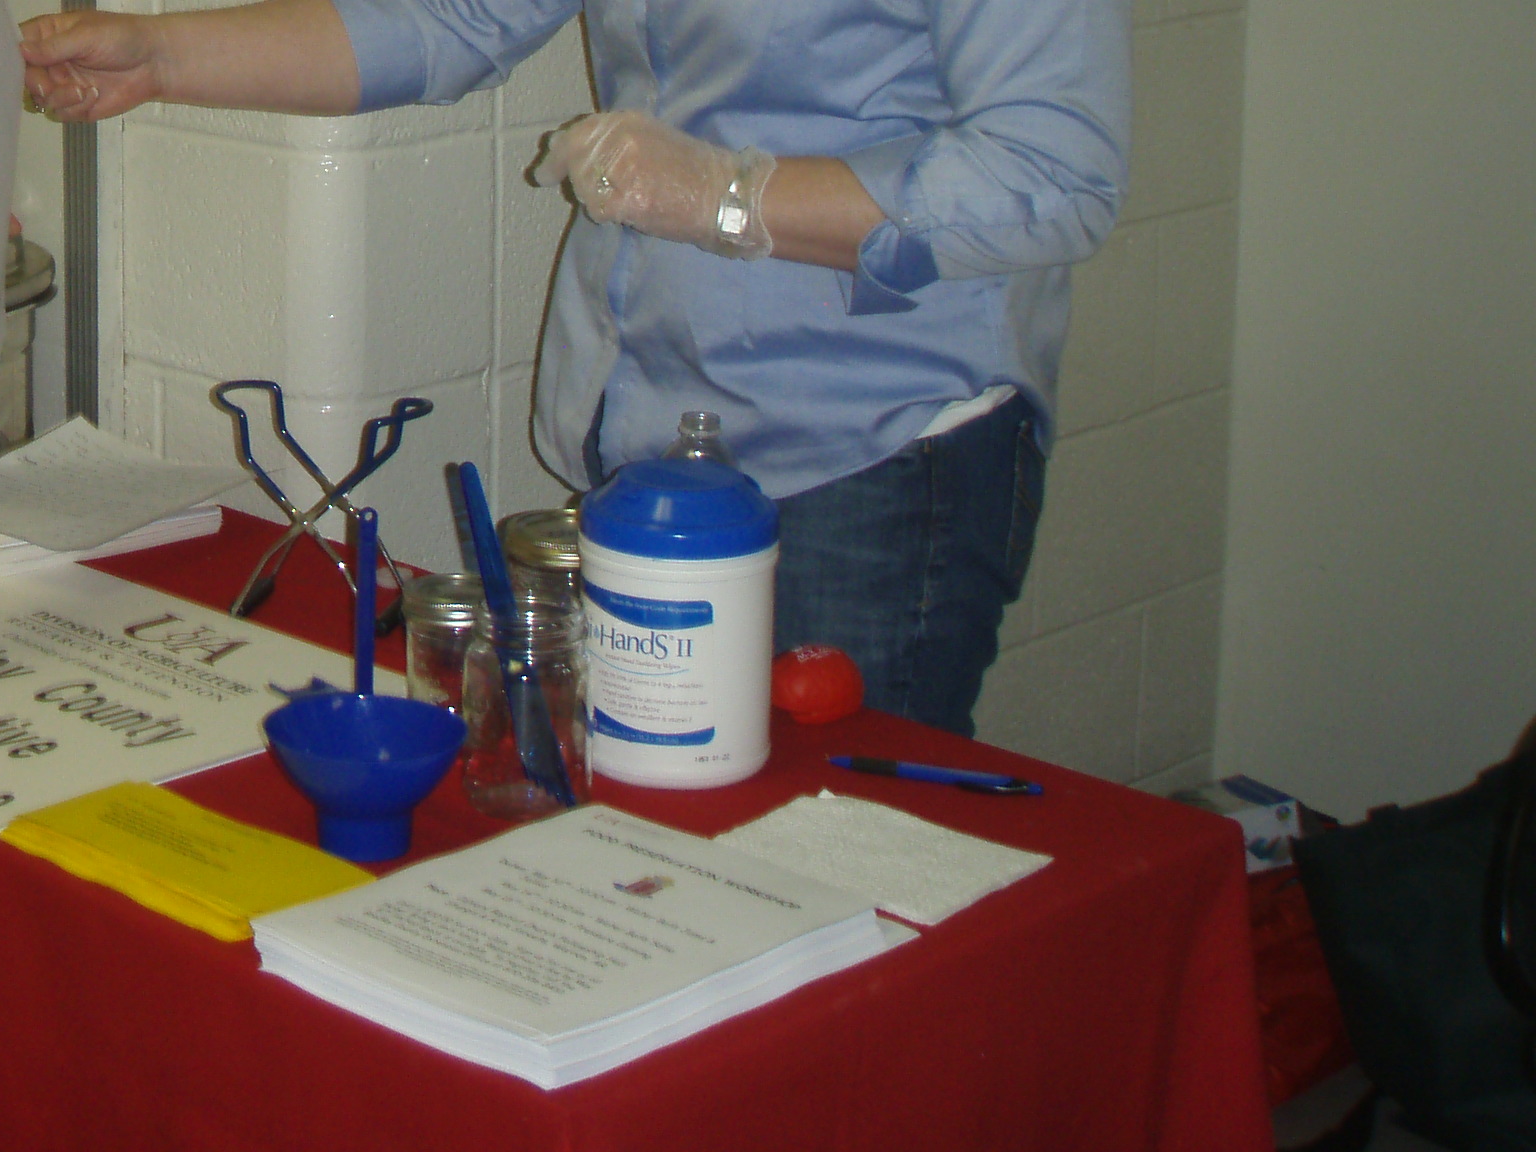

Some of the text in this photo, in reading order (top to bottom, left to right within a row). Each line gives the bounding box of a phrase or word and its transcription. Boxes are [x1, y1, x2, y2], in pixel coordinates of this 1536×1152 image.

[31, 610, 258, 696] DIVISION OF AGRICULTURE
[33, 682, 197, 749] County
